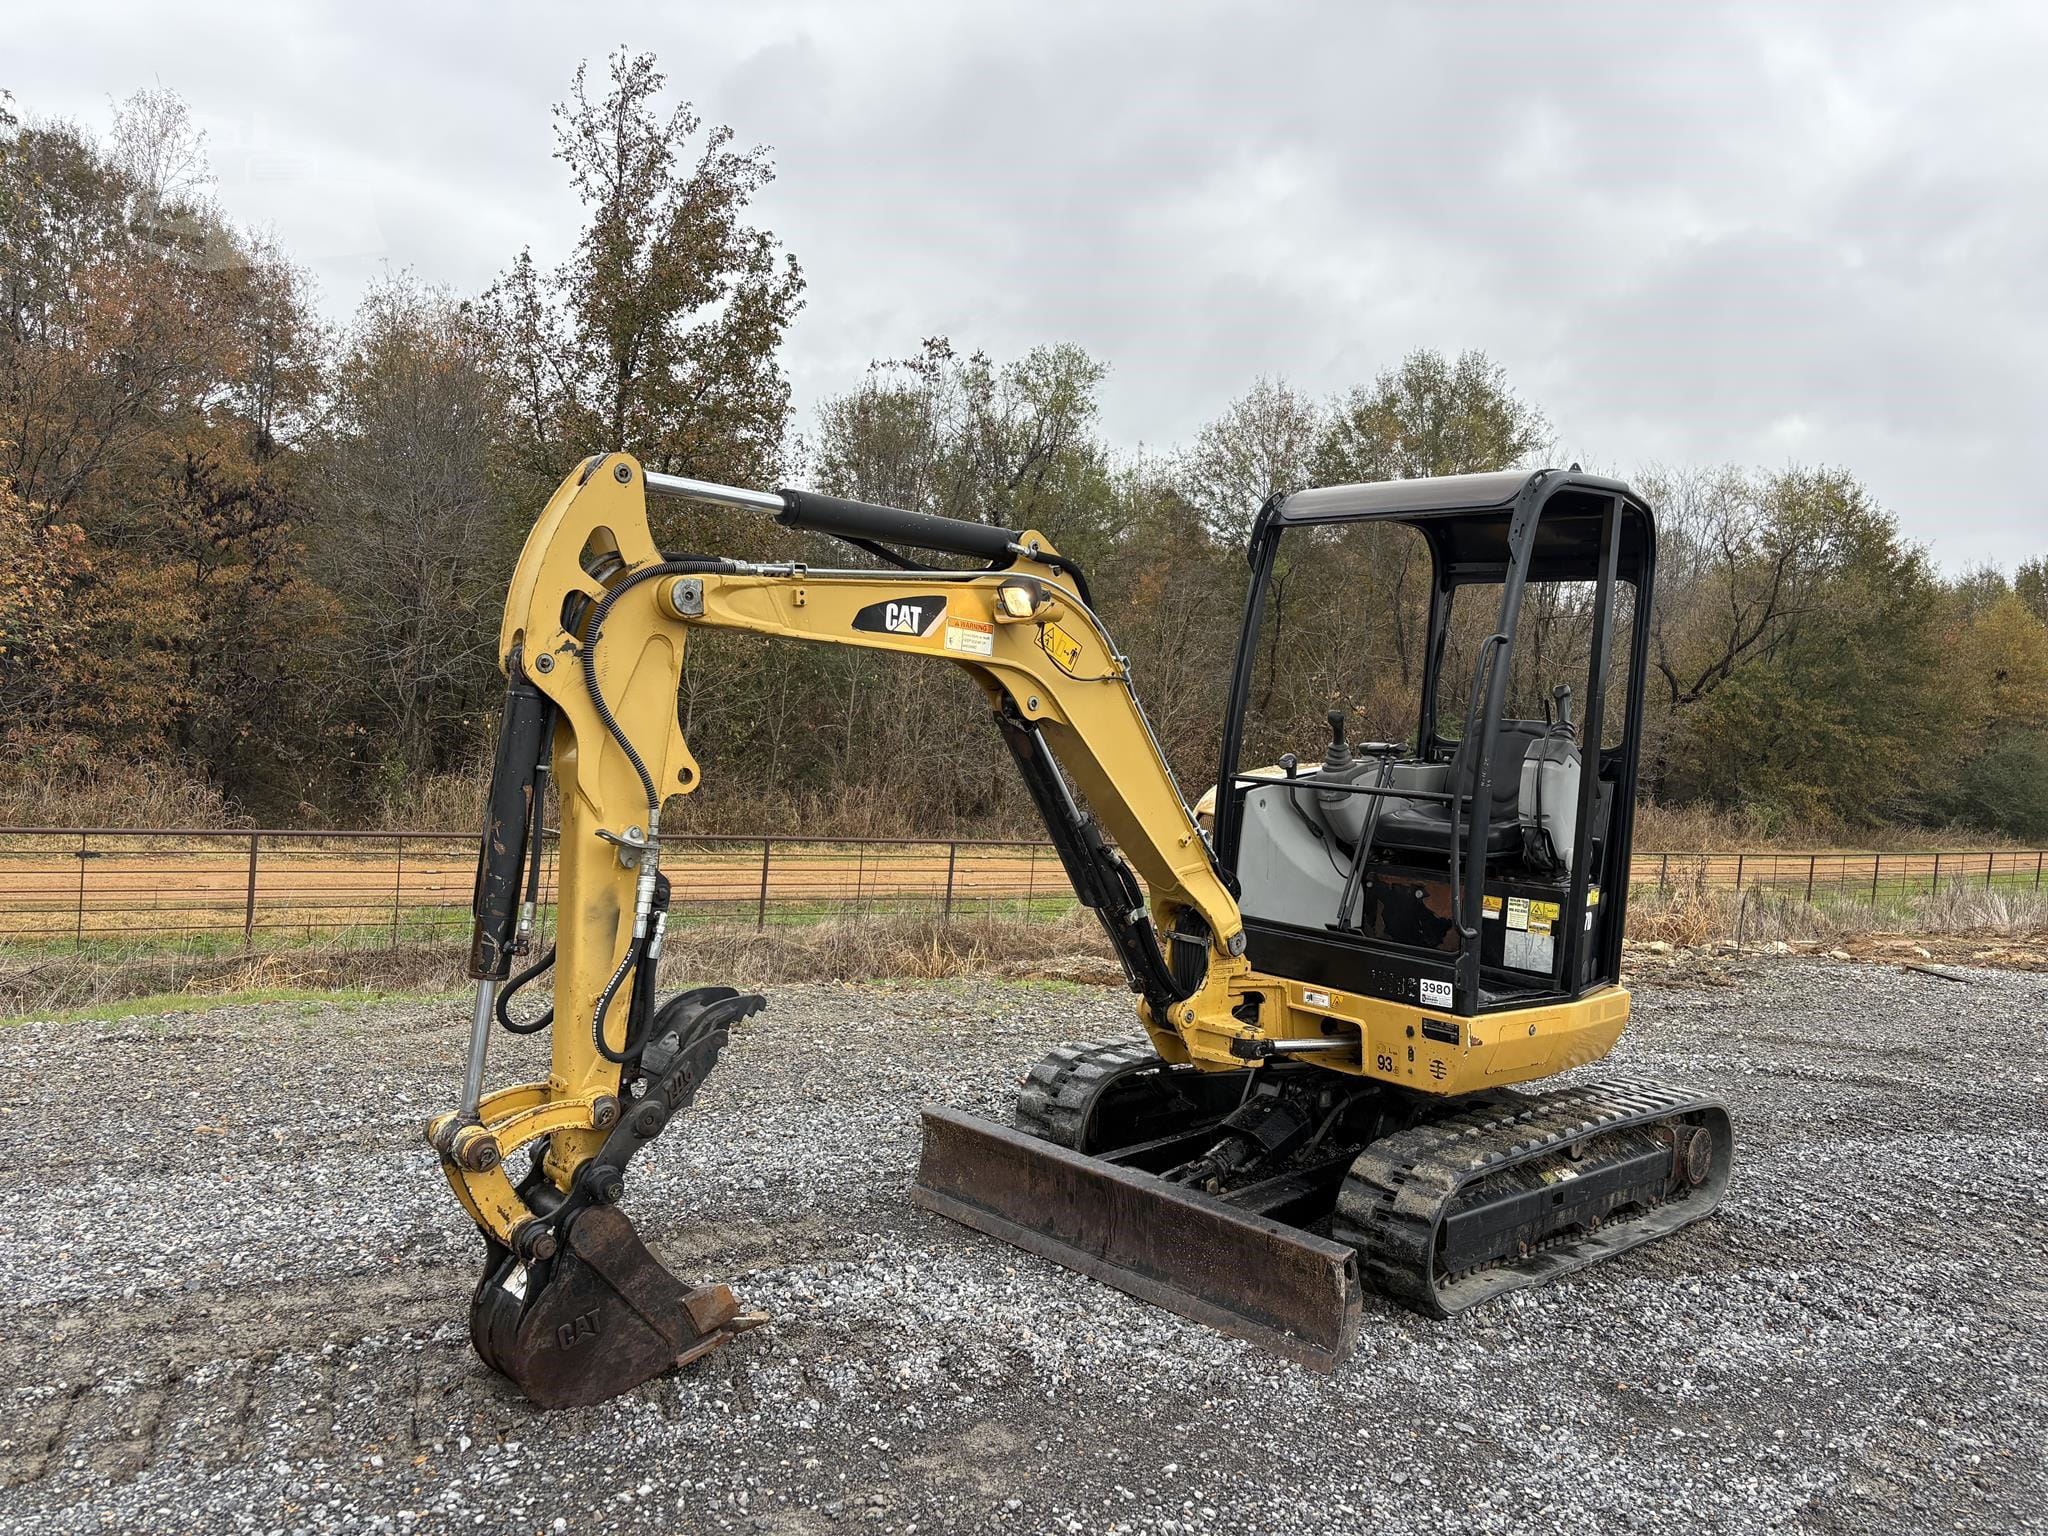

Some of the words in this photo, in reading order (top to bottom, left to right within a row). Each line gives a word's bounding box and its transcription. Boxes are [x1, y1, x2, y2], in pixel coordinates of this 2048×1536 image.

[885, 602, 923, 634] CAT
[960, 621, 987, 632] WARNING
[1422, 981, 1451, 995] 3980
[1377, 1054, 1393, 1072] 93
[557, 1308, 601, 1351] CAT
